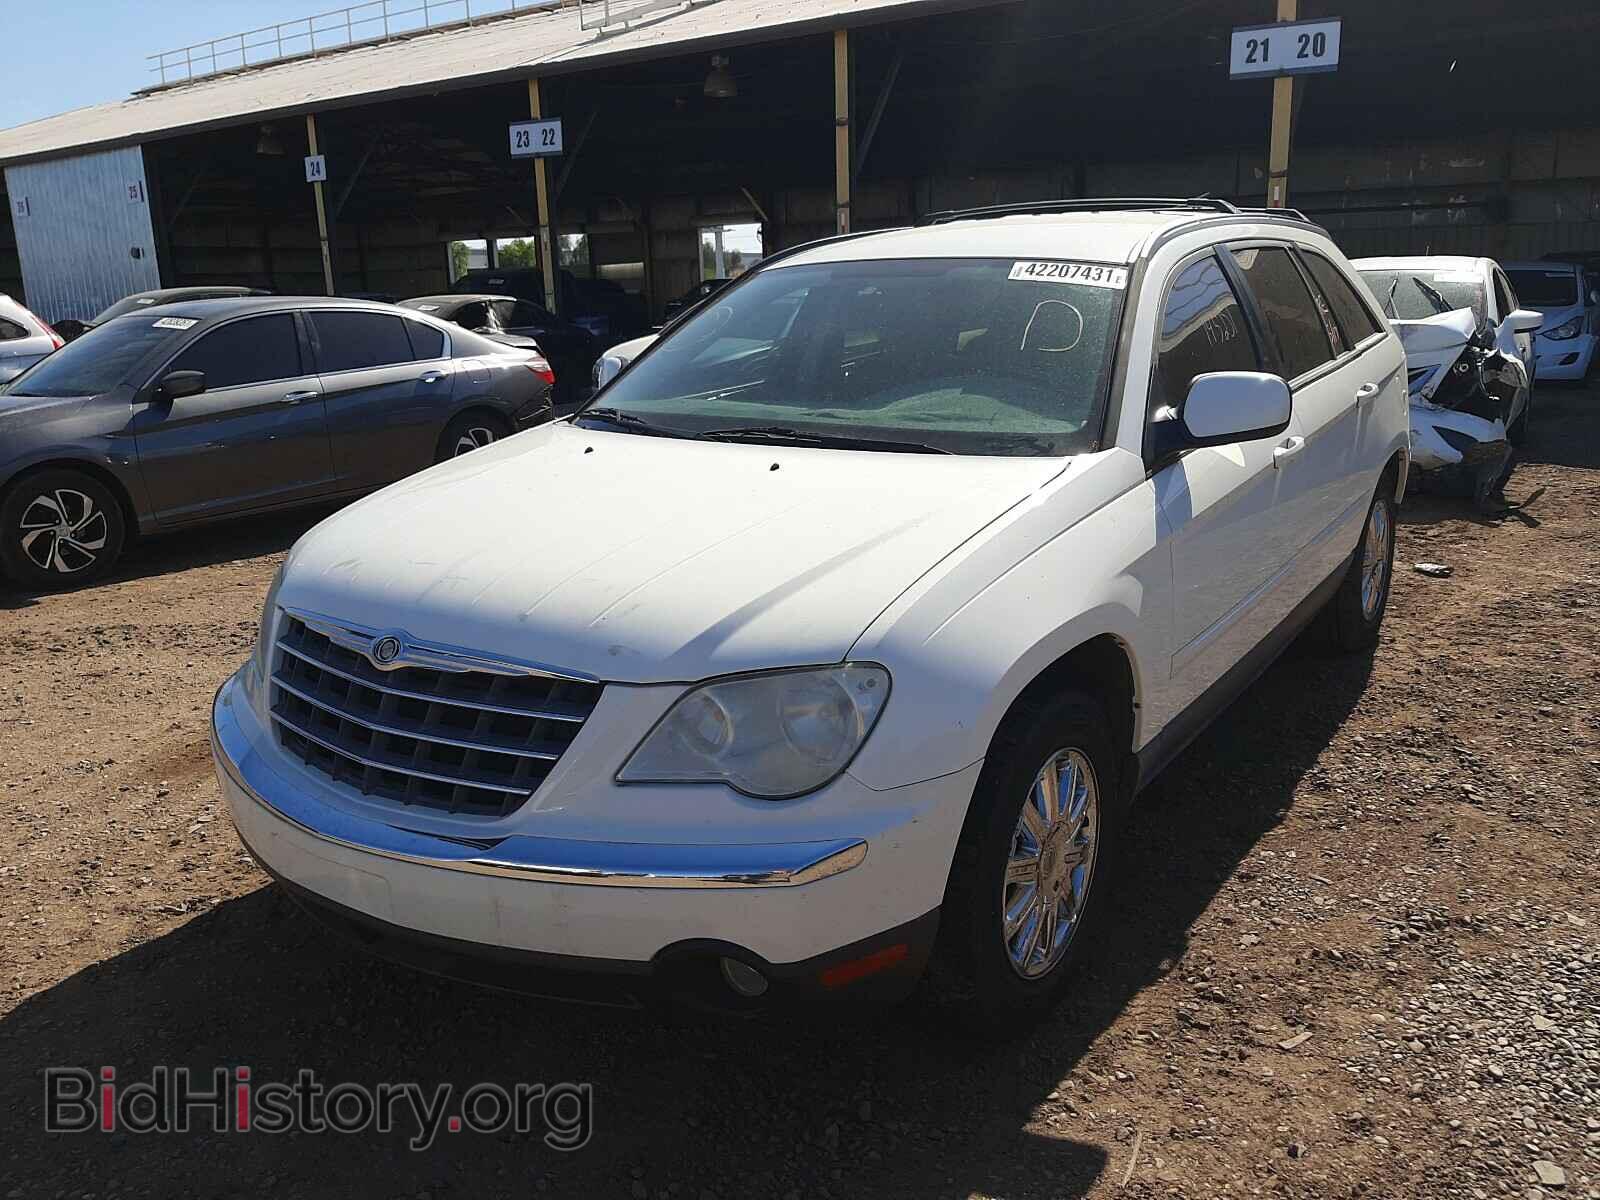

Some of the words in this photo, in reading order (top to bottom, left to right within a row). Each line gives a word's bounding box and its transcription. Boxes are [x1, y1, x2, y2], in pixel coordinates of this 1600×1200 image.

[1245, 37, 1270, 63] 21
[1296, 31, 1326, 58] 20
[516, 130, 530, 148] 23
[541, 128, 556, 146] 22
[310, 161, 321, 176] 24
[1024, 263, 1114, 283] 42207431
